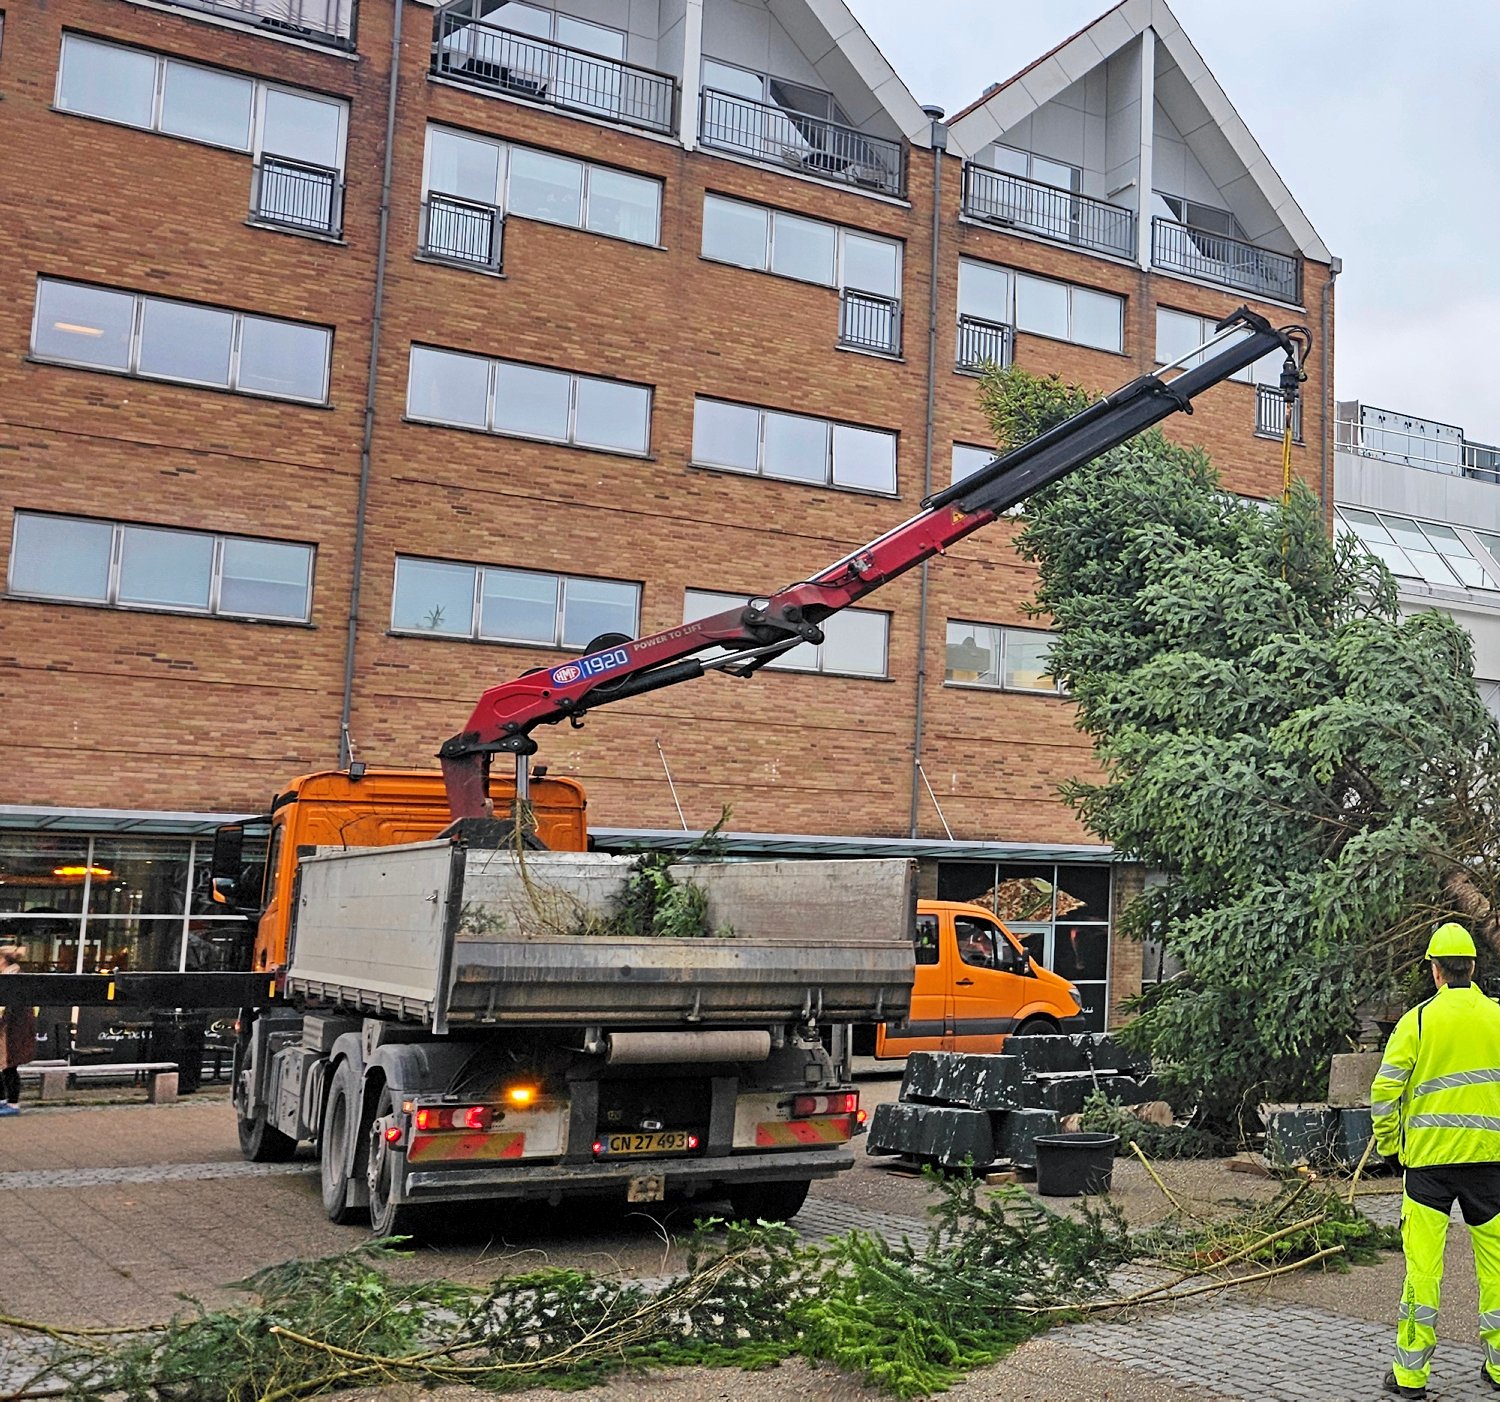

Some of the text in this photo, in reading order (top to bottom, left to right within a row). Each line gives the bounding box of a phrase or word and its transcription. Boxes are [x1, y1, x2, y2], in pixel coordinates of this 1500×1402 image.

[634, 624, 702, 651] POWER TO LIFT
[556, 649, 628, 682] HMF 1920
[610, 1133, 685, 1151] CN 27 493
